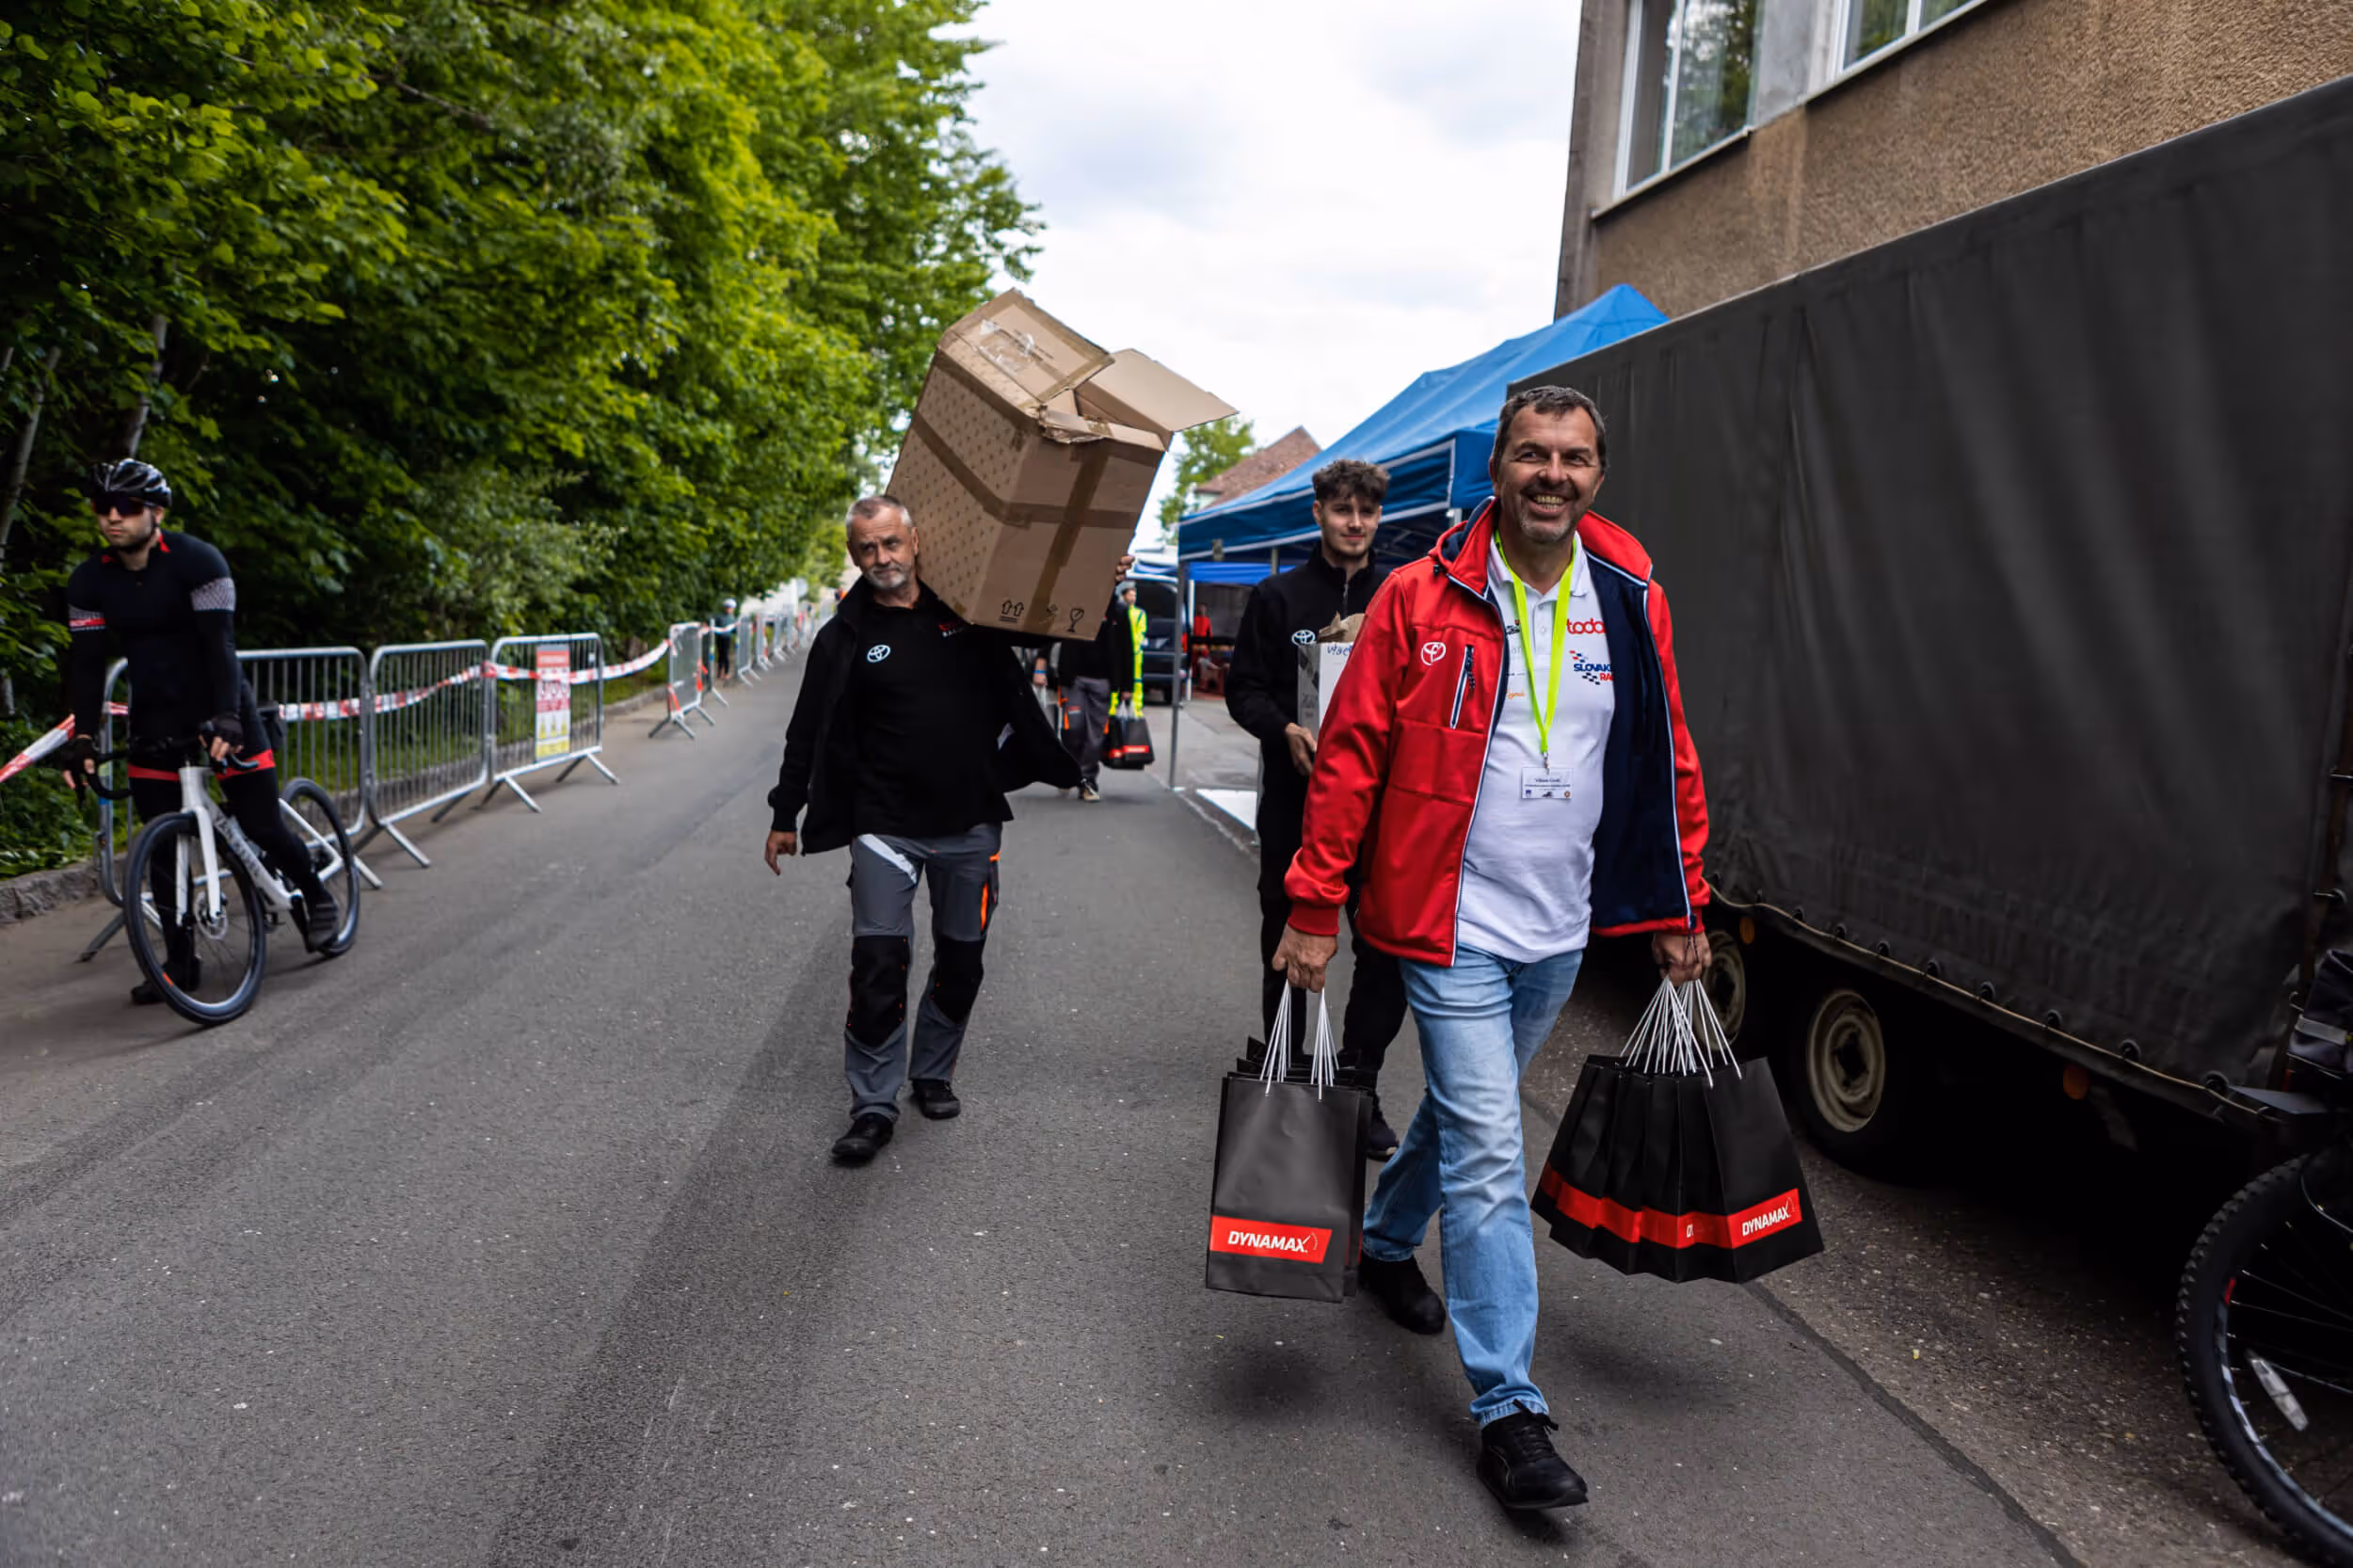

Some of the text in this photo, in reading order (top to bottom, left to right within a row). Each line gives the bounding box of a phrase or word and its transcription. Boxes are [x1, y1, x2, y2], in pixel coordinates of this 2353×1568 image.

[1573, 663, 1612, 673] SLOVAK
[1742, 1204, 1790, 1237] DYNAMAX
[1227, 1231, 1308, 1253] DYNAMAX
